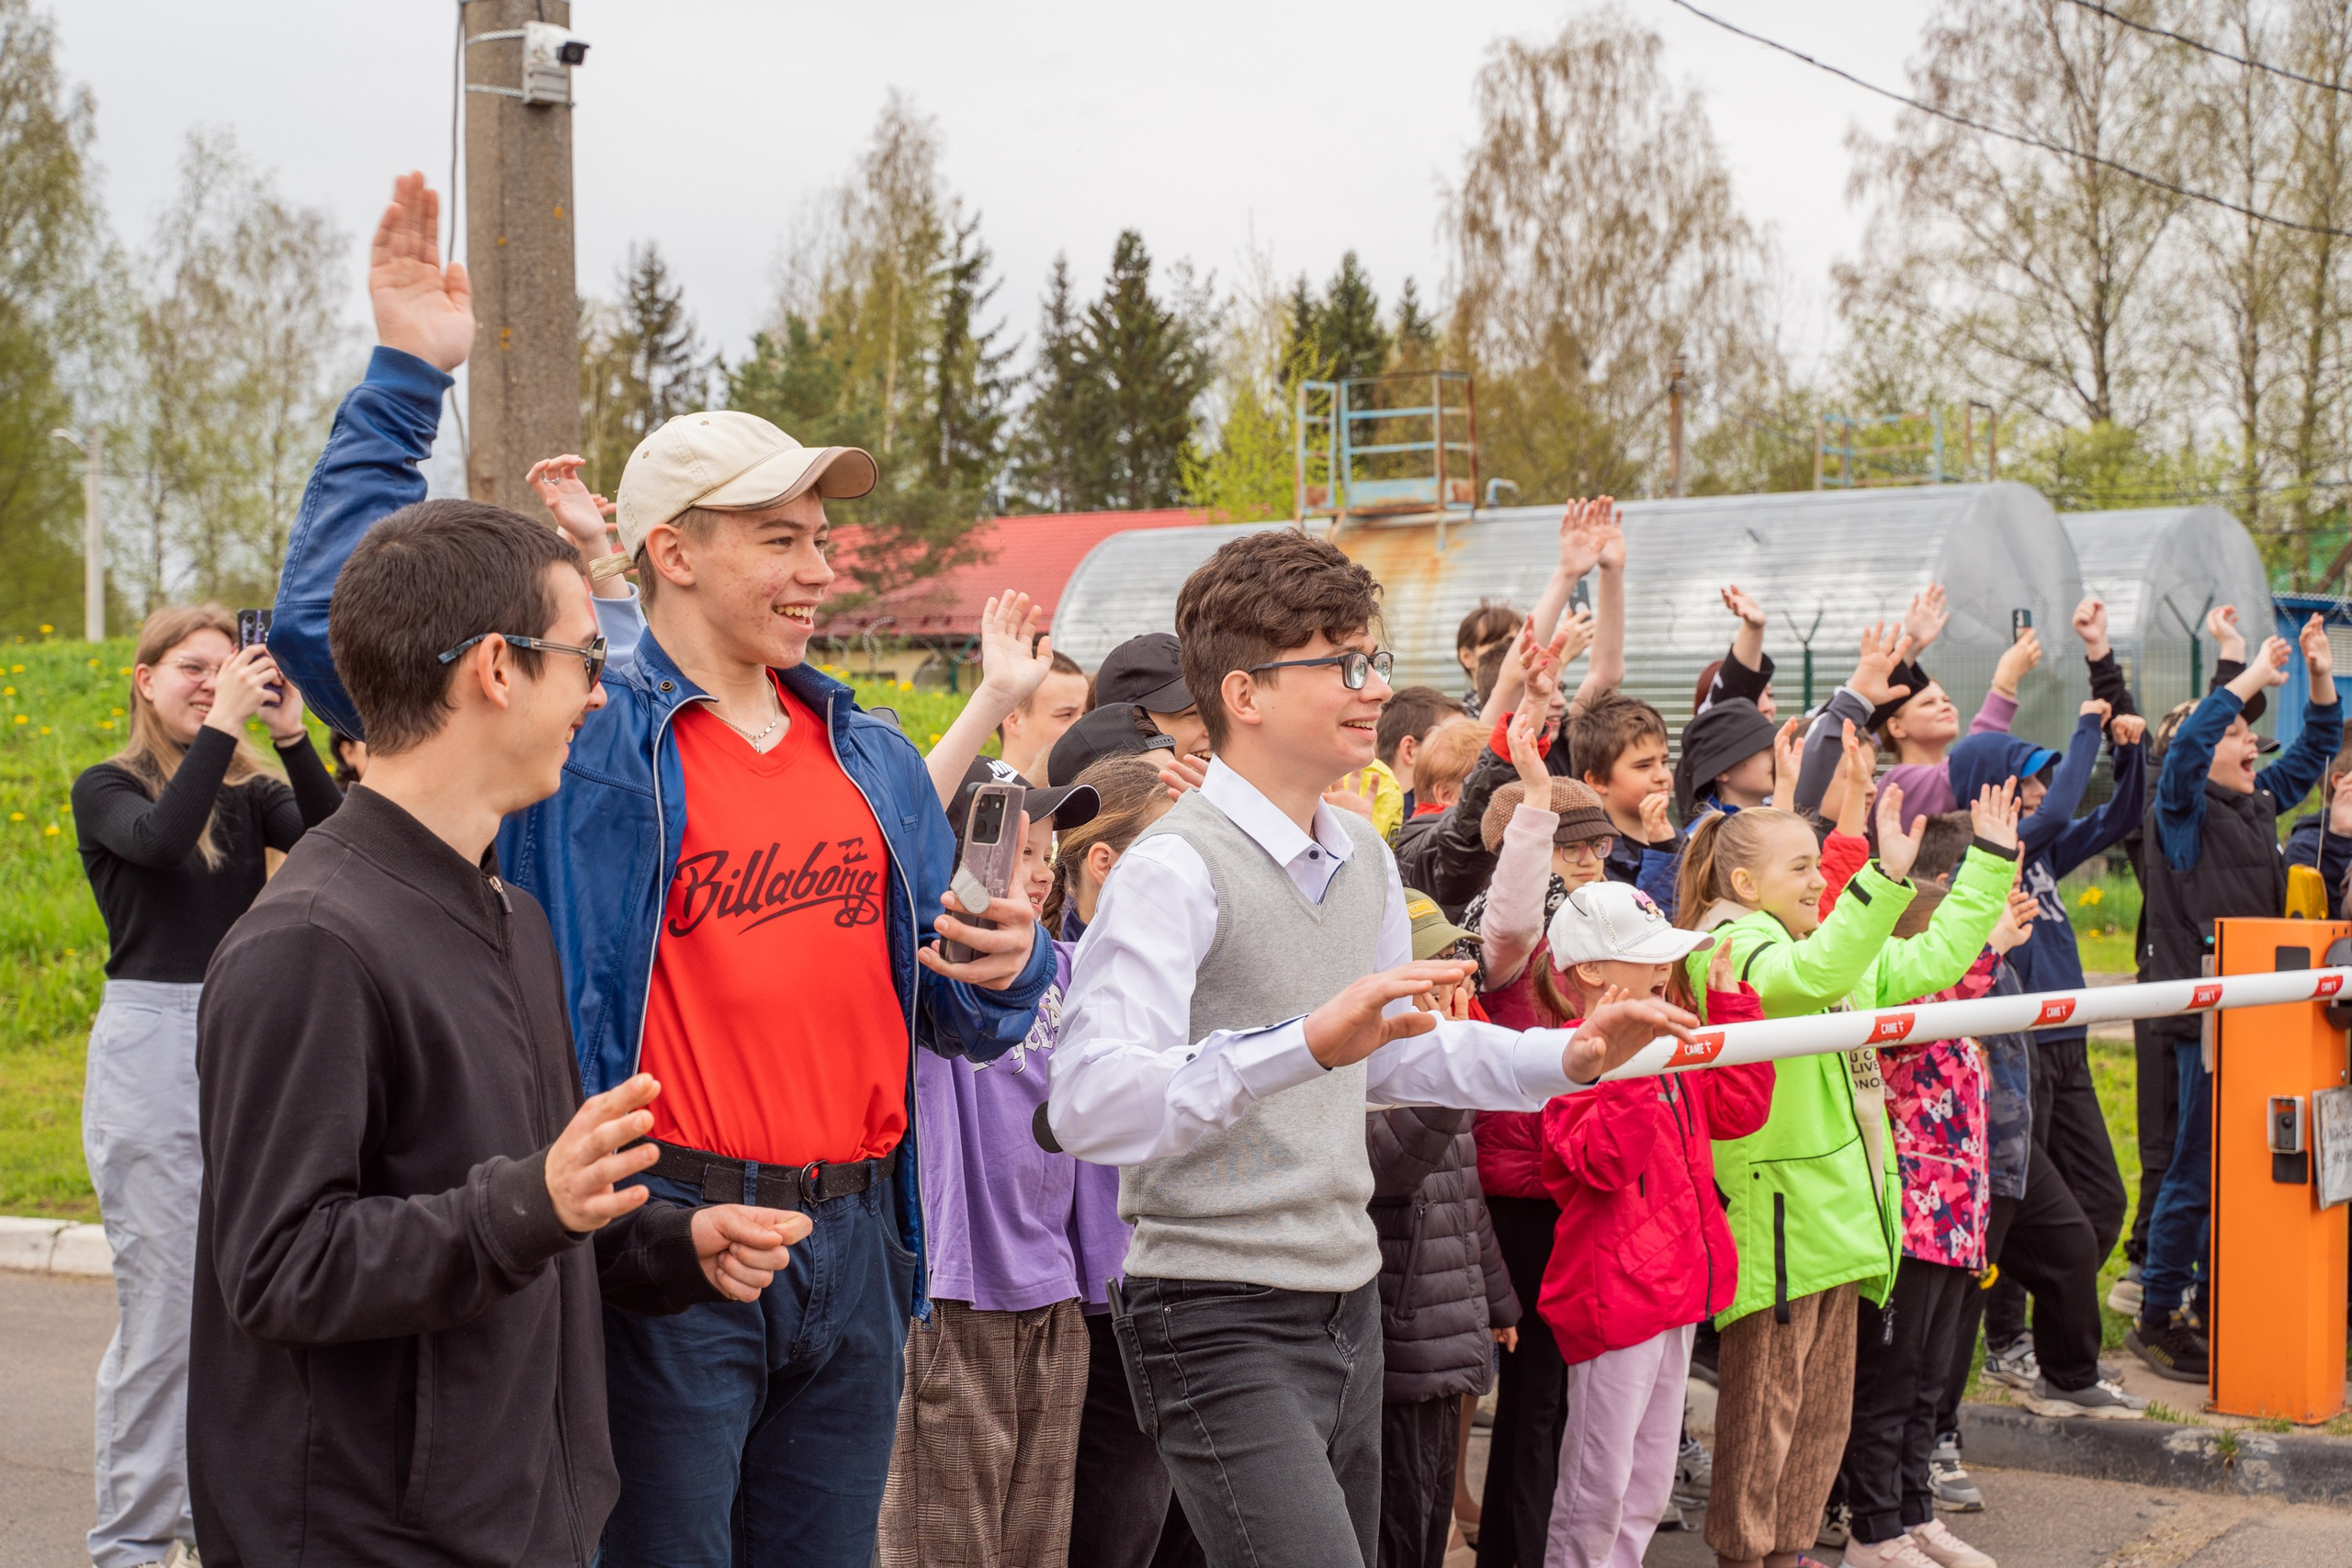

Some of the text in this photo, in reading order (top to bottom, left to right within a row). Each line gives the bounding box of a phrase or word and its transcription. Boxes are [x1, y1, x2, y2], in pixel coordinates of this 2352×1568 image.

[668, 841, 880, 938] Billabong
[1881, 1021, 1898, 1034] CAME
[1684, 1043, 1705, 1055] CAME
